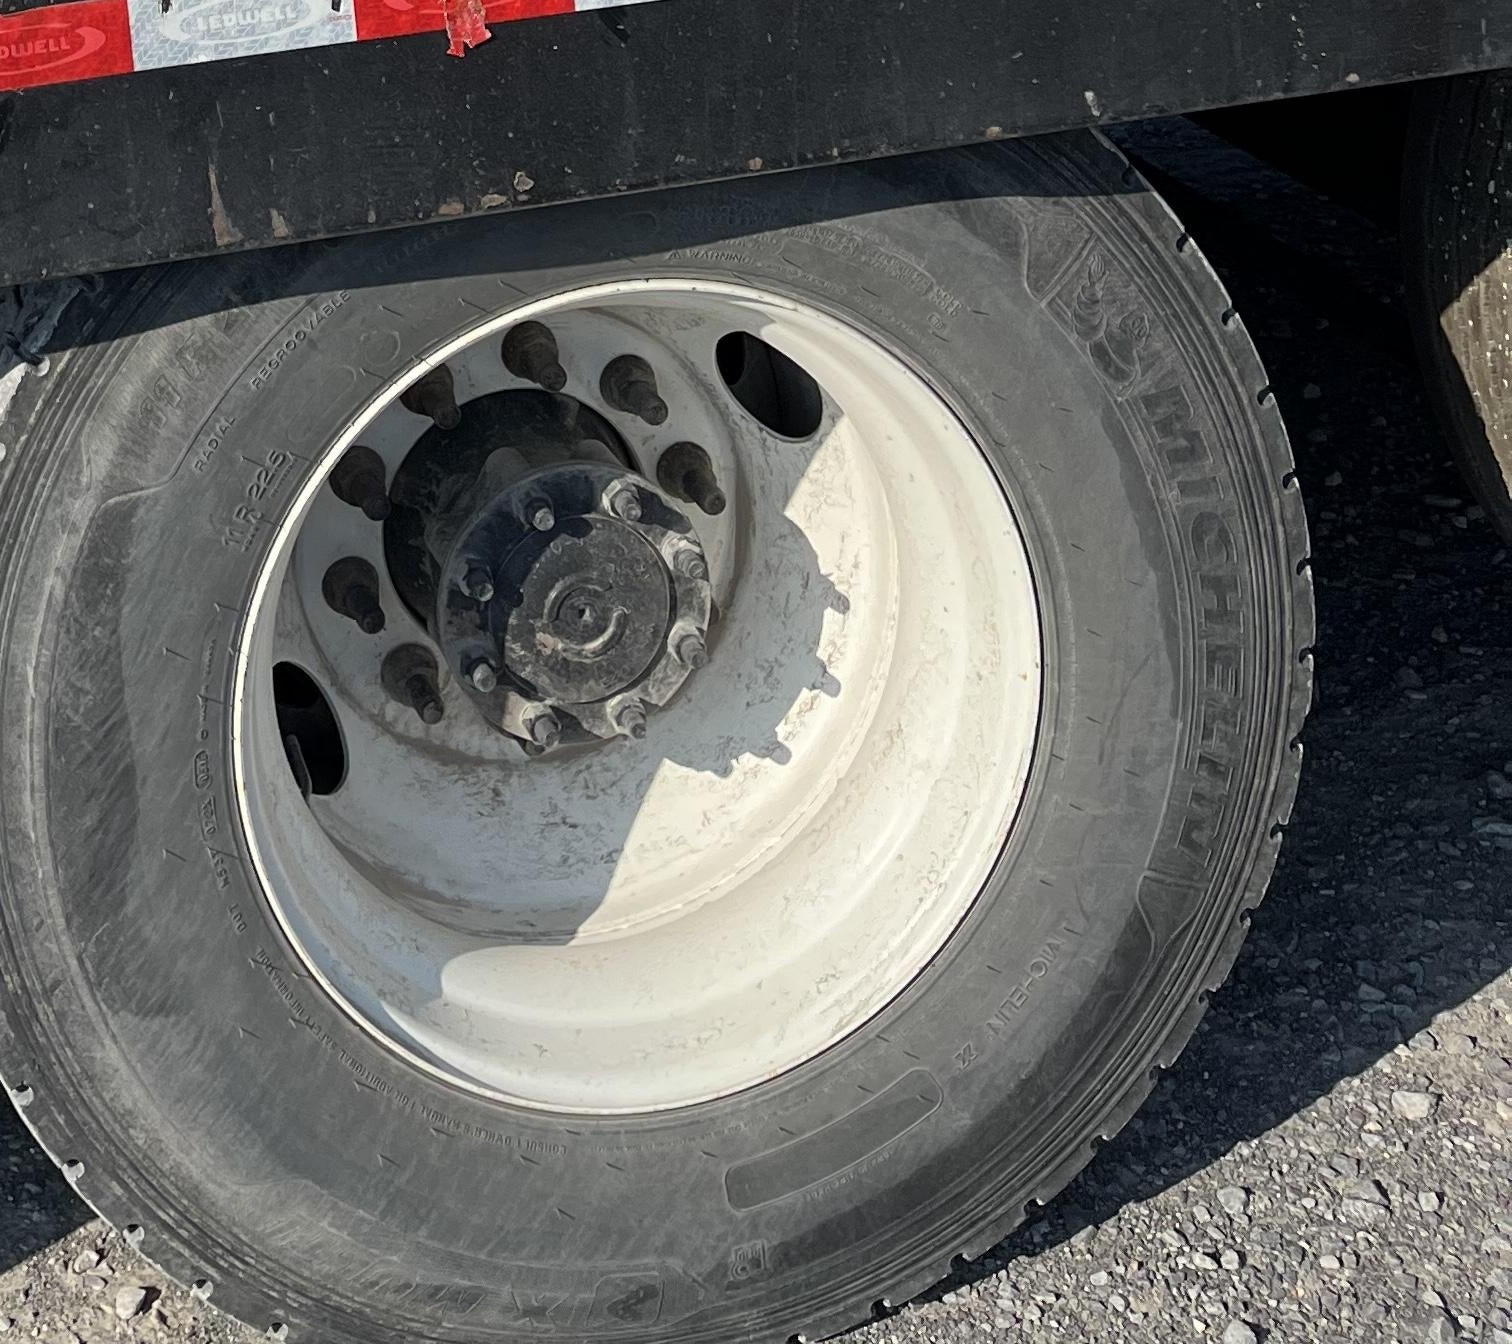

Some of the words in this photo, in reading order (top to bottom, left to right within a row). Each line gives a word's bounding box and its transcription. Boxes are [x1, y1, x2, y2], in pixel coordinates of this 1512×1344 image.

[196, 6, 300, 34] LEDWELL
[689, 247, 753, 266] WARNING
[250, 289, 353, 391] REGROOVABLE
[192, 416, 236, 473] RADIAL
[1141, 384, 1246, 869] MICHELIN
